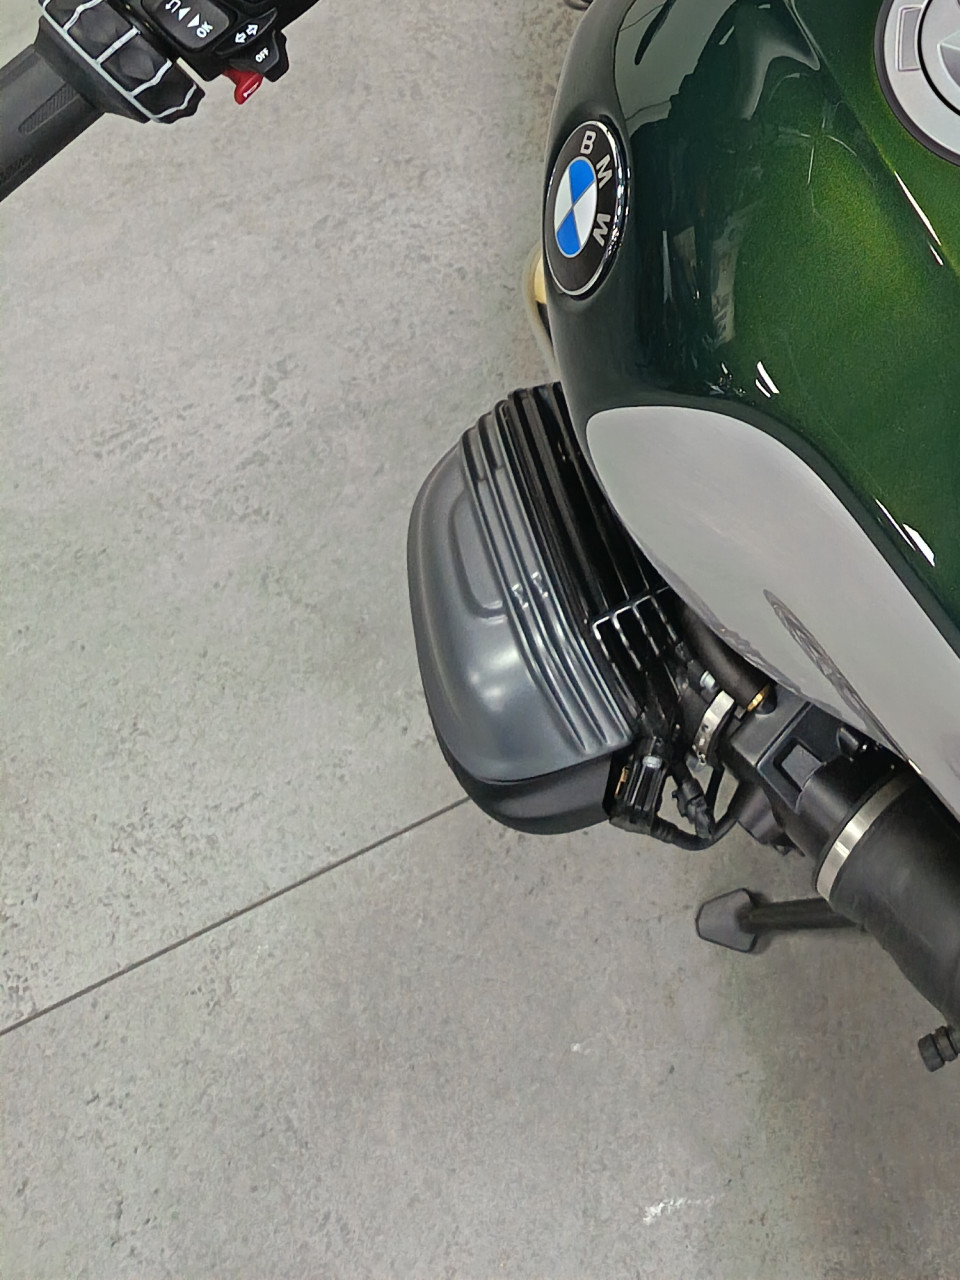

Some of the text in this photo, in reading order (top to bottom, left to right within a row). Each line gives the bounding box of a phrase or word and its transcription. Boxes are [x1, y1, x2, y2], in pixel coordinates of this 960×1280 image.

[196, 21, 213, 38] OK
[255, 47, 269, 63] OFF
[580, 130, 613, 247] BMW
